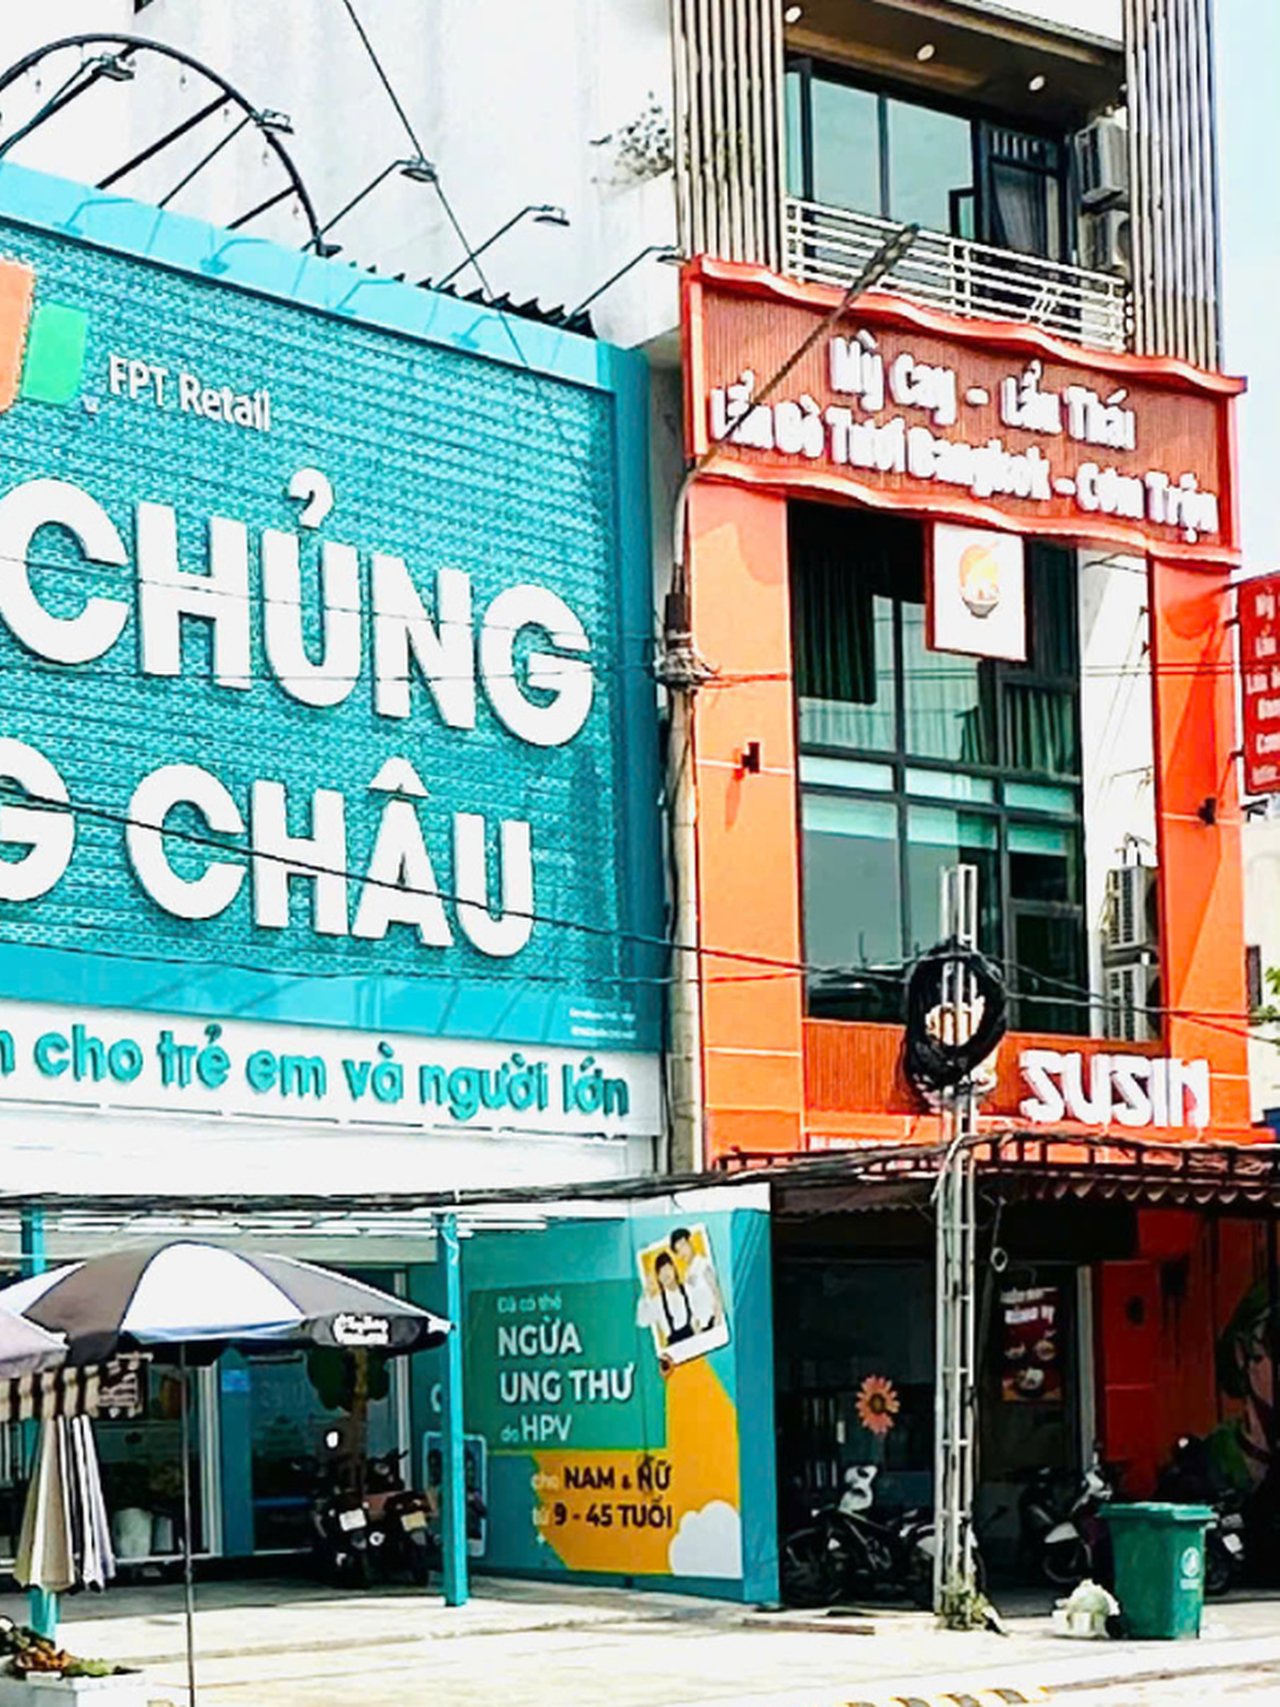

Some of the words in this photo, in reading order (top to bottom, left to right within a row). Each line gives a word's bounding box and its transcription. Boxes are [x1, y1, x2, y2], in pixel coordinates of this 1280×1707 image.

[110, 354, 170, 408] FPT
[179, 372, 270, 432] Retail
[890, 353, 957, 426] Cay
[1001, 360, 1062, 434] Lẩu
[1062, 385, 1136, 450] Thái
[125, 756, 535, 958] CHÂU
[34, 1024, 144, 1082] cho
[157, 1023, 232, 1088] trẻ
[246, 1049, 327, 1098] em
[341, 1041, 404, 1101] và
[418, 1052, 549, 1121] người
[561, 1056, 630, 1117] lớn
[498, 1314, 582, 1357] NGỪA
[500, 1371, 561, 1402] UNG
[568, 1362, 635, 1401] THƯ
[521, 1414, 572, 1442] HPV
[564, 1466, 615, 1489] NAM
[554, 1502, 568, 1526] 9
[586, 1503, 613, 1527] 45
